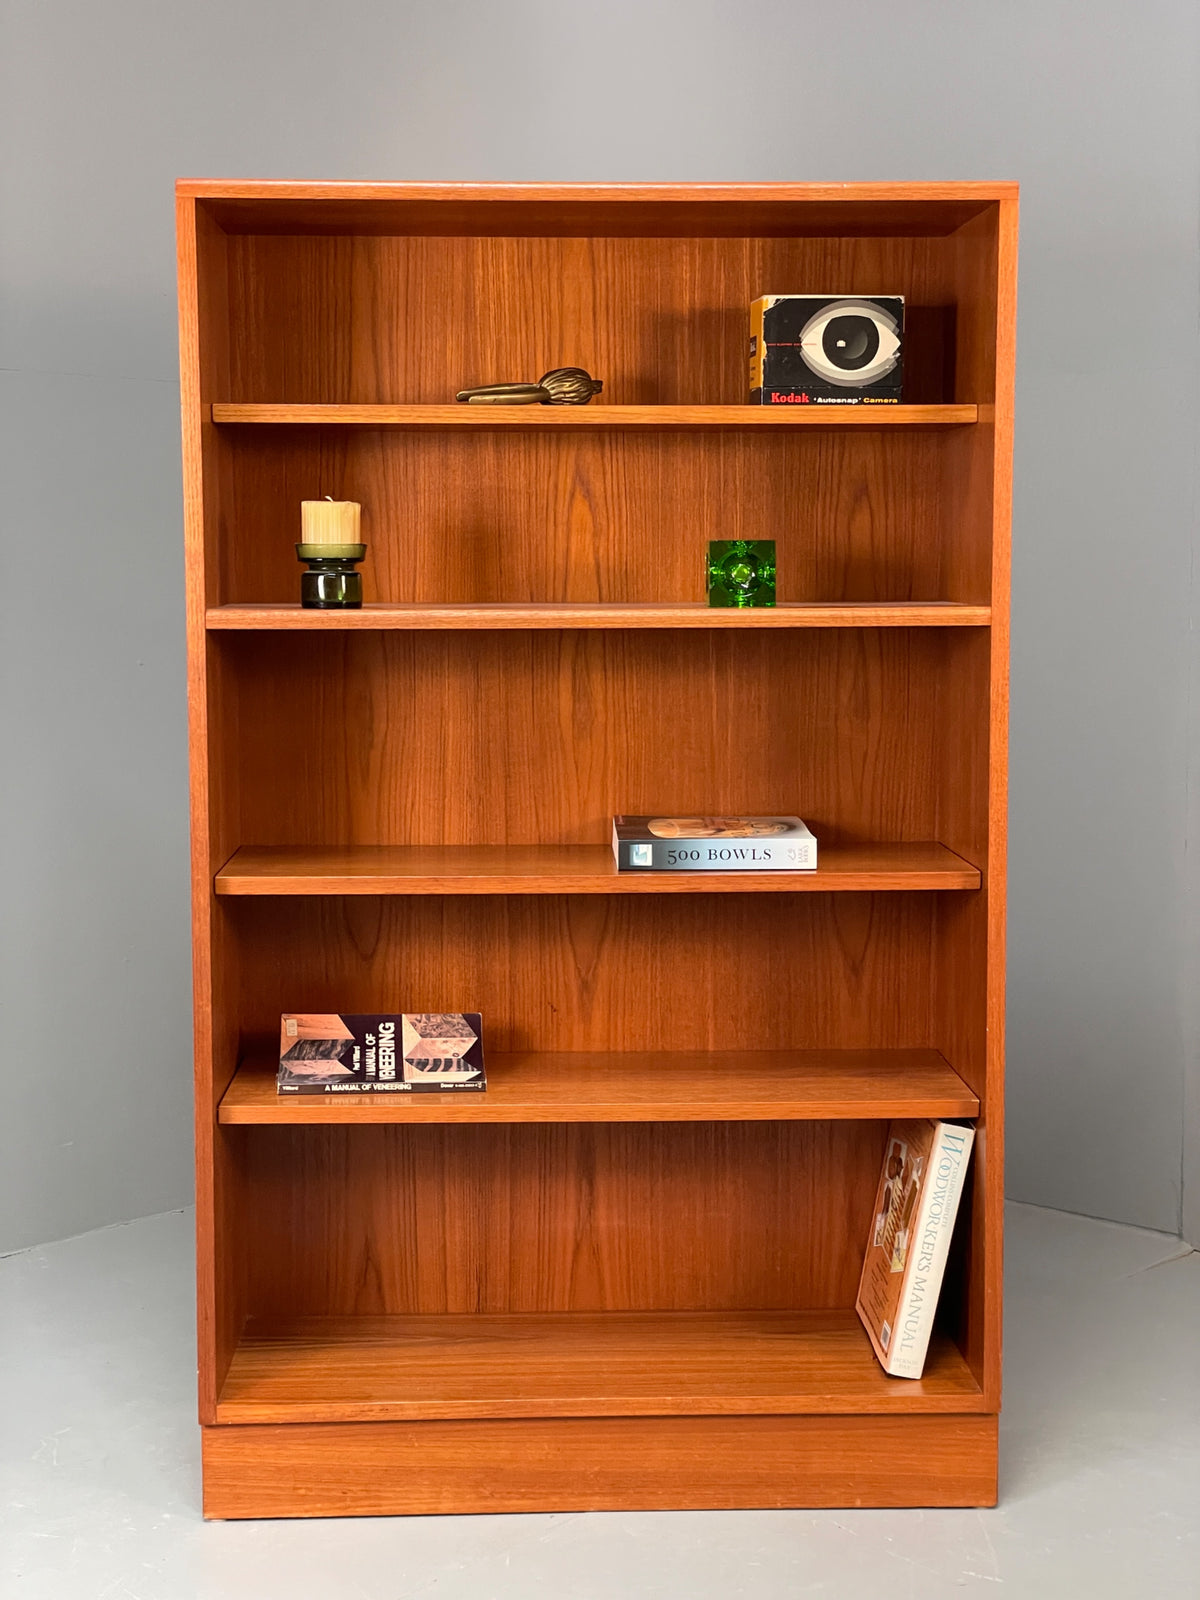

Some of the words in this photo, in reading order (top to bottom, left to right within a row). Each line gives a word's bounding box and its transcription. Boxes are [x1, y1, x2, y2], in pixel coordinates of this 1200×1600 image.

[771, 393, 809, 403] Kodak
[667, 849, 700, 865] 500
[708, 848, 772, 861] BOWLS
[365, 1033, 376, 1046] OF
[365, 1046, 376, 1071] MANUAL
[378, 1022, 396, 1081] VENEERING
[325, 1084, 331, 1092] A
[331, 1084, 361, 1092] MANUAL
[361, 1083, 372, 1091] OF
[373, 1083, 412, 1091] VENEERING
[917, 1133, 966, 1273] WOODWORKER'S
[900, 1275, 928, 1353] MANUAL
